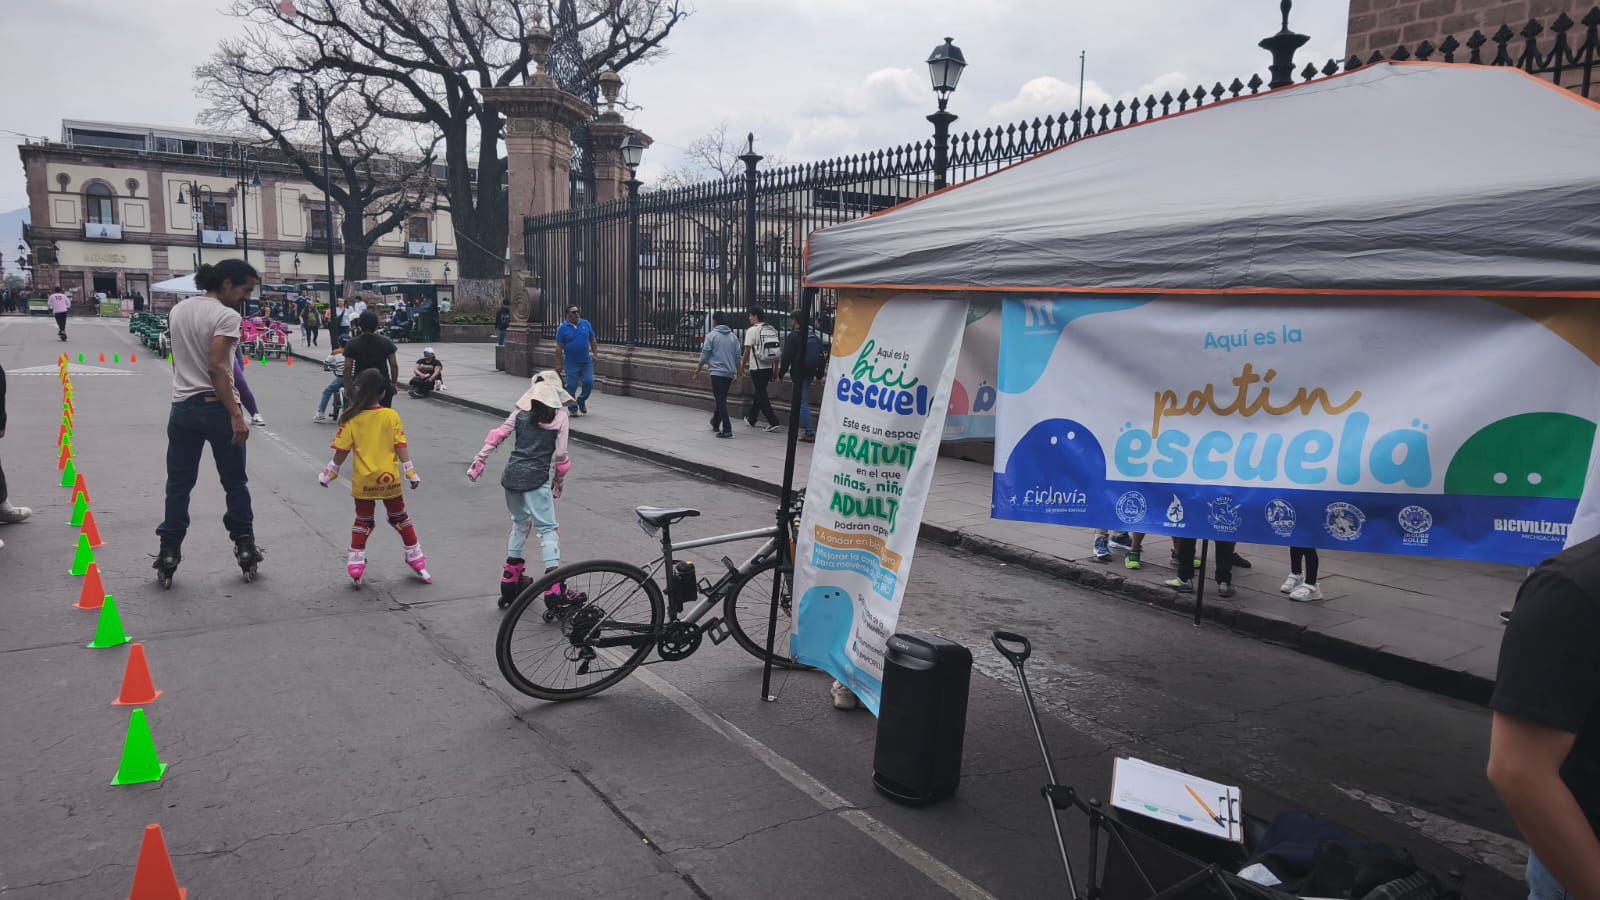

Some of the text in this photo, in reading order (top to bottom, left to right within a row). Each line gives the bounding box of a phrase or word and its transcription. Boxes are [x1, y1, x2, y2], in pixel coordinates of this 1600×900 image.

[1204, 323, 1303, 352] Aquí es la
[851, 339, 919, 389] bici
[877, 347, 910, 361] Aquí es la
[836, 376, 934, 417] escuel
[1152, 363, 1363, 439] patín
[843, 417, 859, 430] Este
[861, 424, 870, 433] es
[872, 427, 883, 437] un
[1114, 411, 1433, 488] escuela
[833, 473, 871, 494] niñas,
[856, 467, 901, 480] en el que
[1024, 485, 1087, 505] ciclovía
[834, 520, 870, 531] podrán
